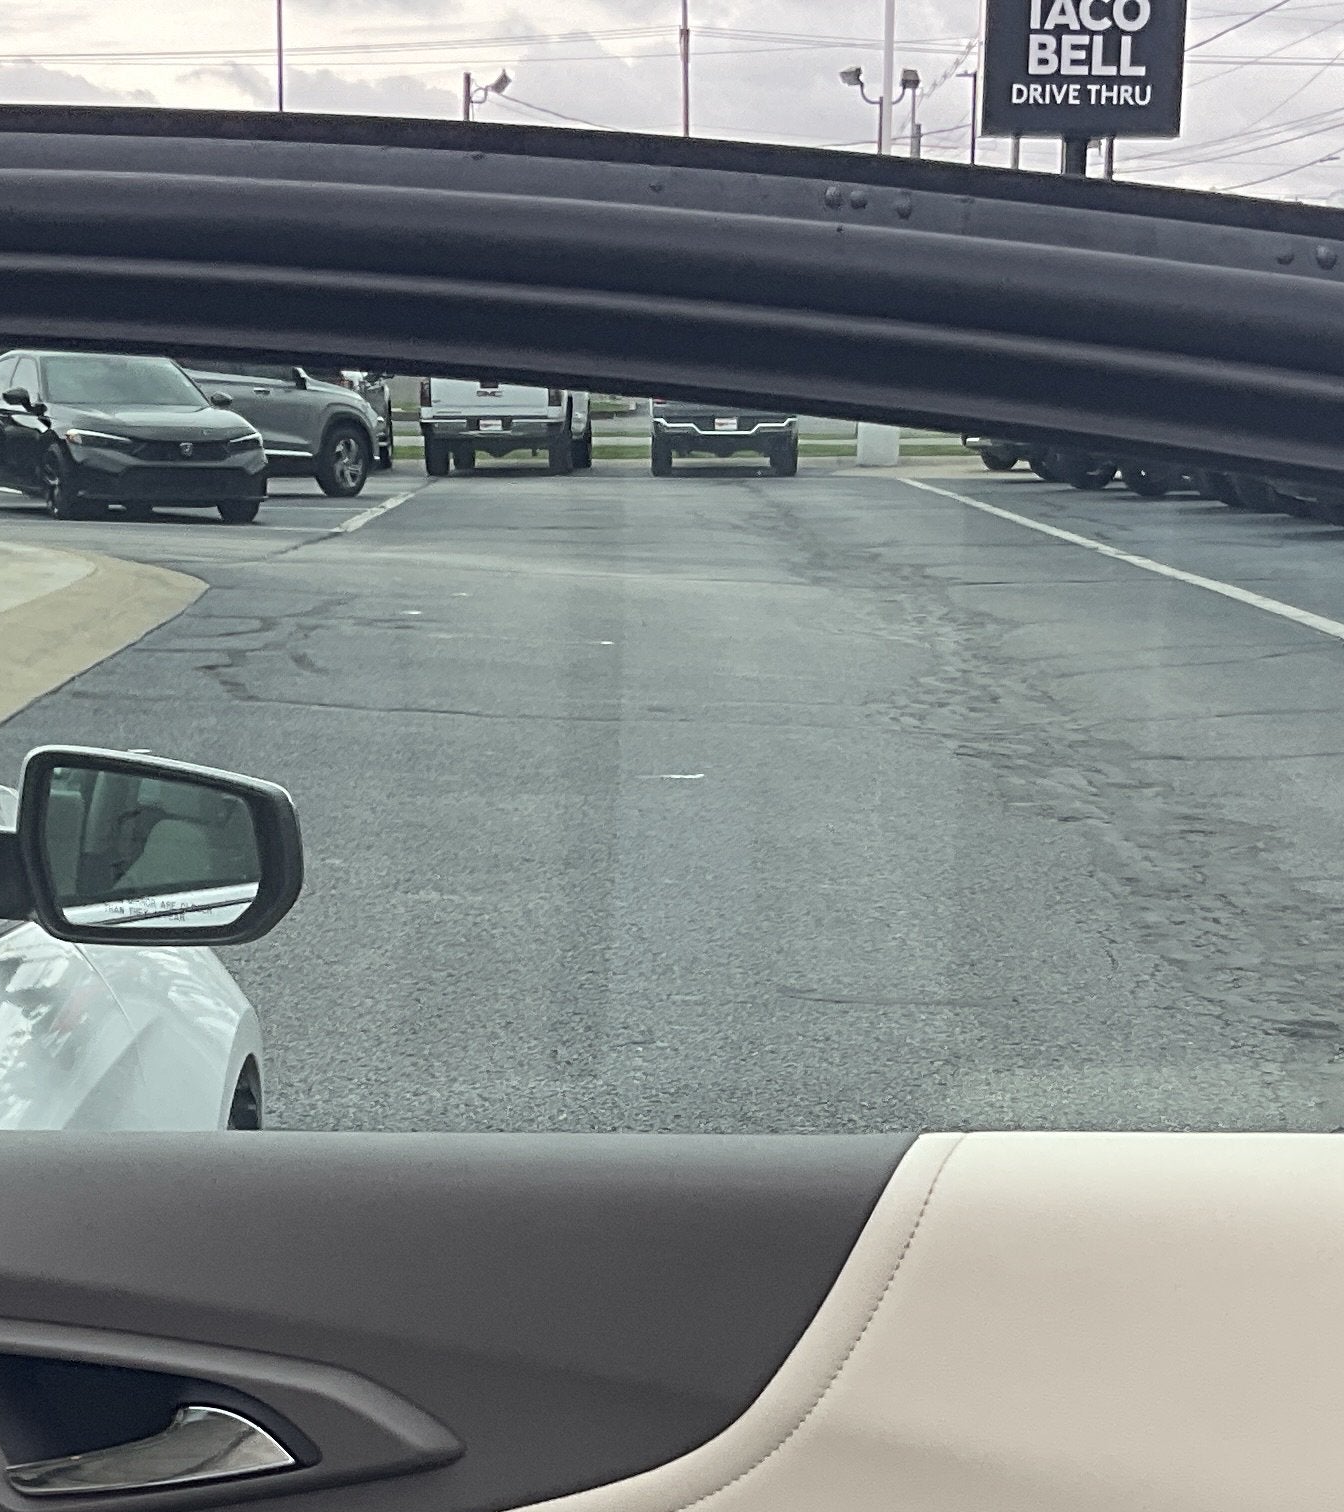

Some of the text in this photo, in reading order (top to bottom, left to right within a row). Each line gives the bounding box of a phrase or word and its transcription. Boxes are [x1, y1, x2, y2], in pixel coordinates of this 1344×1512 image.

[1030, 0, 1151, 32] TACO
[1028, 33, 1146, 77] BELL
[1011, 83, 1152, 106] DRIVE THRU
